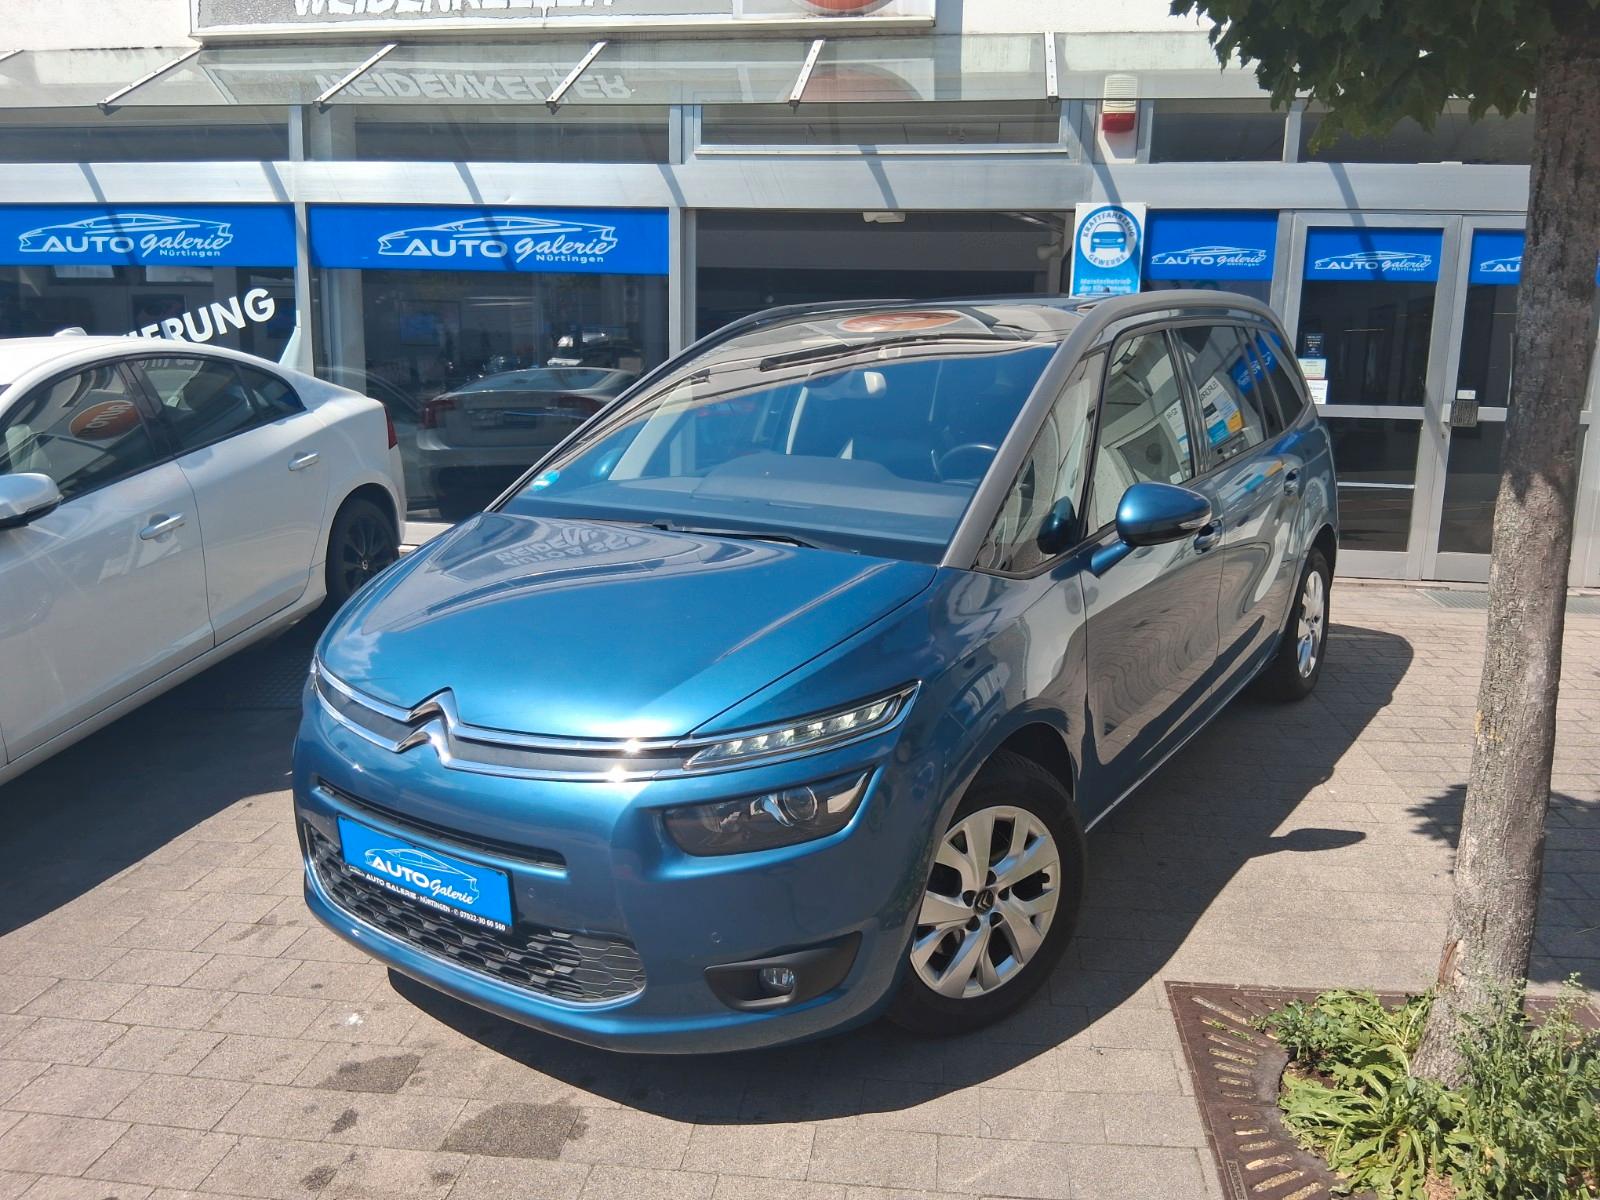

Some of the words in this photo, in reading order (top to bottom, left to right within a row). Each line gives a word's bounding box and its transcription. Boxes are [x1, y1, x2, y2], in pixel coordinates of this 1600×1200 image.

[42, 236, 134, 254] AUTO
[404, 239, 508, 258] AUTO
[159, 249, 221, 258] Nürtingen
[536, 254, 604, 264] Nürtingen
[1164, 256, 1214, 265] AUTO
[1328, 262, 1378, 270] AUTO
[1493, 263, 1521, 272] AU
[370, 856, 430, 889] AUTO
[365, 873, 385, 887] AUTO
[386, 882, 417, 900] GALERIE
